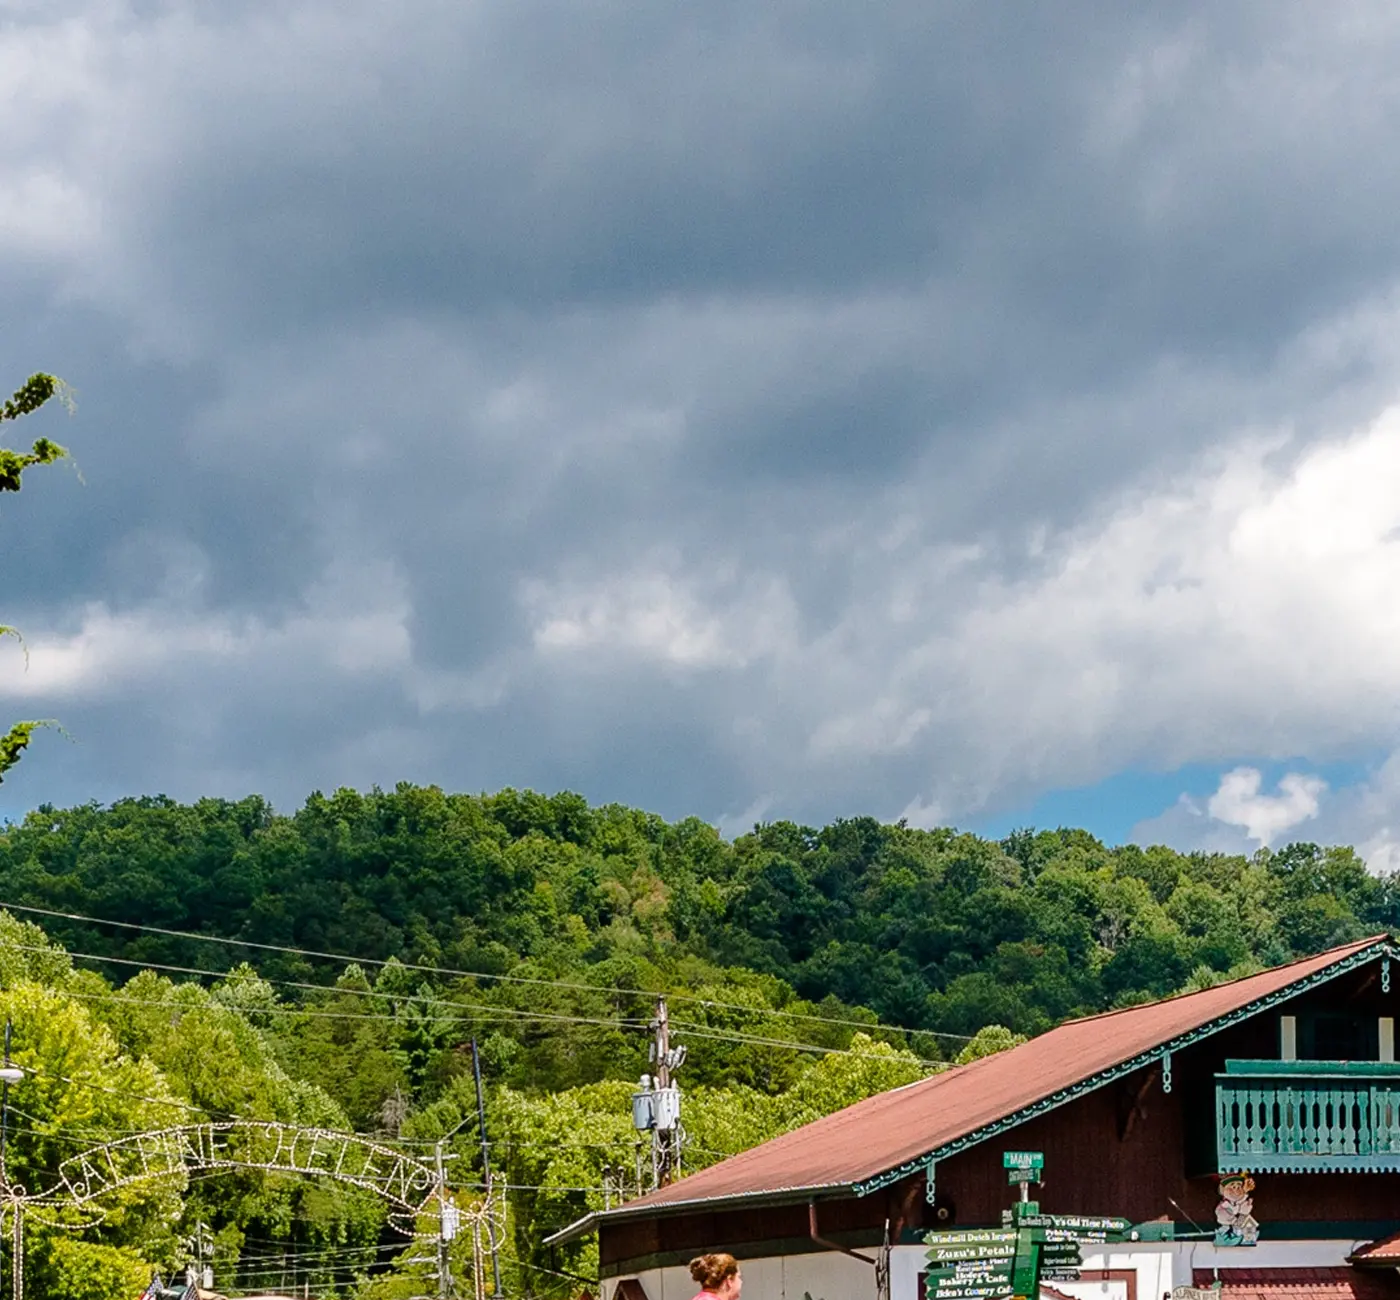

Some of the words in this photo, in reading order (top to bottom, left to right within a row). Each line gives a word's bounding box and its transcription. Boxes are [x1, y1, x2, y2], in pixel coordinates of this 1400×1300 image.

[1010, 1153, 1032, 1164] MAIN
[1067, 1219, 1080, 1227] Old
[1081, 1219, 1100, 1228] Time
[1102, 1220, 1124, 1229] Photo
[931, 1234, 966, 1244] Windmill
[967, 1233, 991, 1242] Dutch
[937, 1248, 975, 1259] Zuzu's
[979, 1245, 1015, 1257] Petals
[939, 1277, 974, 1286] Bakery
[986, 1274, 1008, 1284] Cafe
[964, 1286, 995, 1296] Country
